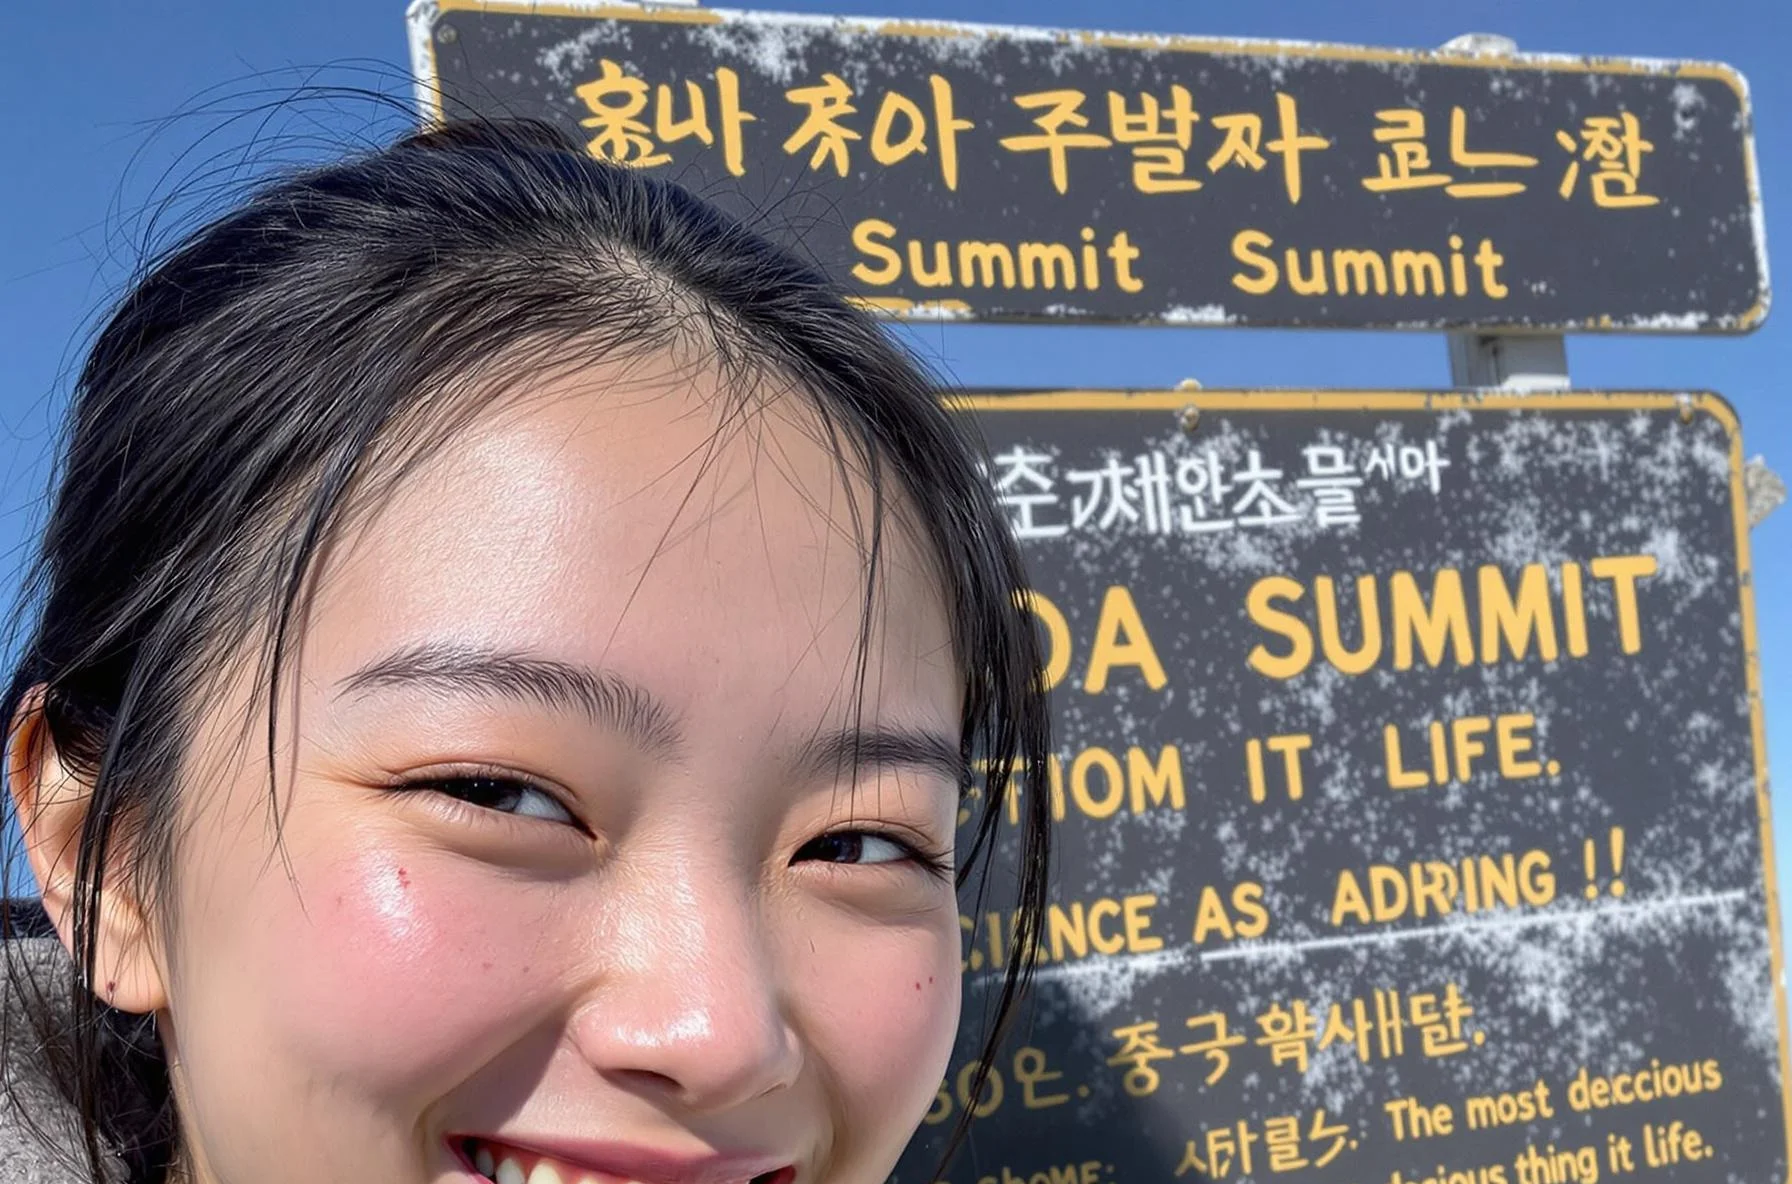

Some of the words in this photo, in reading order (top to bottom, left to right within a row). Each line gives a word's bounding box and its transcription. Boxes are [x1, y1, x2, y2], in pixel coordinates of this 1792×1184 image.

[850, 218, 1144, 294] Summit
[1231, 229, 1509, 299] Summit
[1246, 555, 1658, 680] SUMMIT
[1245, 734, 1312, 804] IT
[1384, 713, 1561, 790] LIFE.
[1193, 881, 1270, 945] AS
[1385, 1096, 1454, 1142] The
[1466, 1078, 1555, 1131] most
[1605, 1132, 1636, 1175] it
